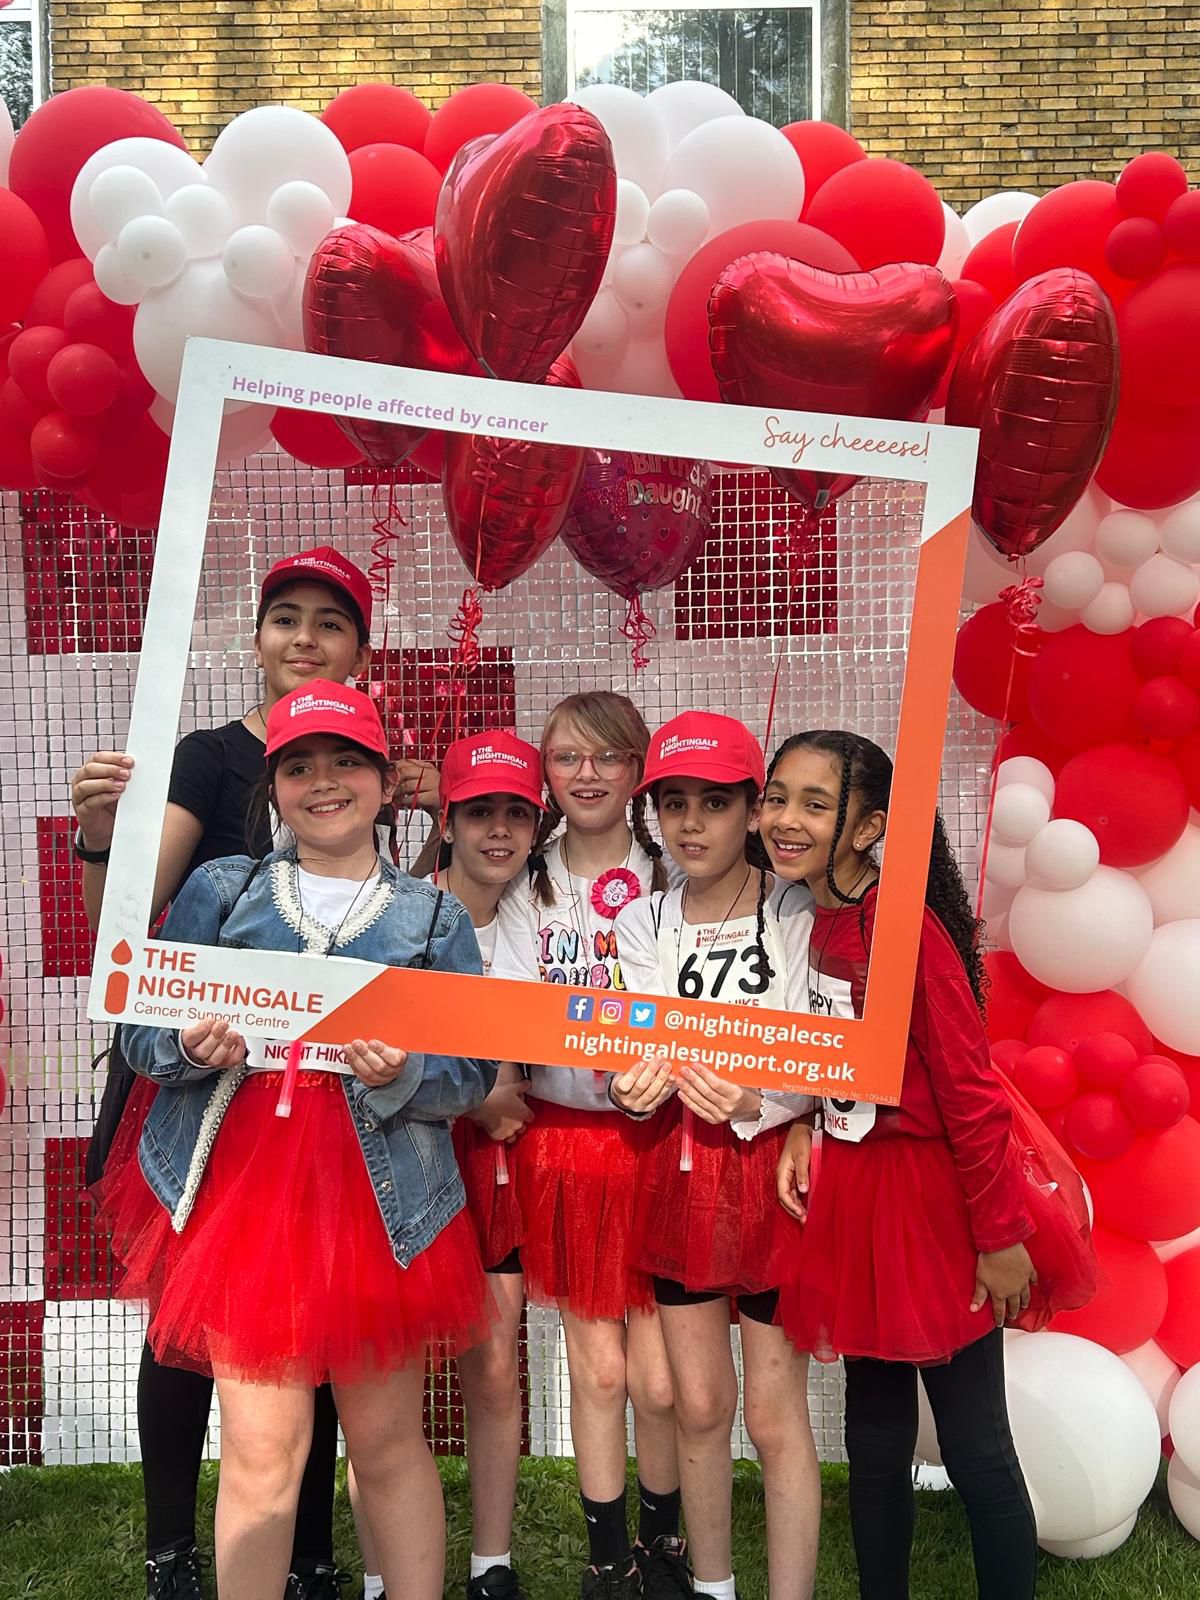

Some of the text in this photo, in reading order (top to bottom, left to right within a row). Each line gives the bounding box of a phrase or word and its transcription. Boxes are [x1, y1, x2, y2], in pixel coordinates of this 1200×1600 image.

[232, 376, 549, 433] Helping people affected by cancer
[763, 415, 931, 464] Say cheeeese!
[296, 694, 314, 704] THE
[296, 699, 356, 714] NIGHTINGALE
[665, 738, 718, 752] NIGHTINGALE
[666, 735, 679, 745] THE
[477, 751, 528, 768] NIGHTINGALE
[538, 928, 579, 964] IN
[701, 930, 750, 942] NIGHTINGALE
[143, 947, 197, 973] THE
[678, 945, 770, 999] 673
[137, 975, 324, 1014] NIGHTINGALE
[134, 1001, 182, 1018] Cancer
[245, 1013, 290, 1029] Centre
[664, 1010, 844, 1049] @nightingalecsc
[564, 1031, 856, 1083] nightingalesupport.org.uk
[782, 1082, 821, 1093] Registered
[822, 1087, 848, 1098] Charity
